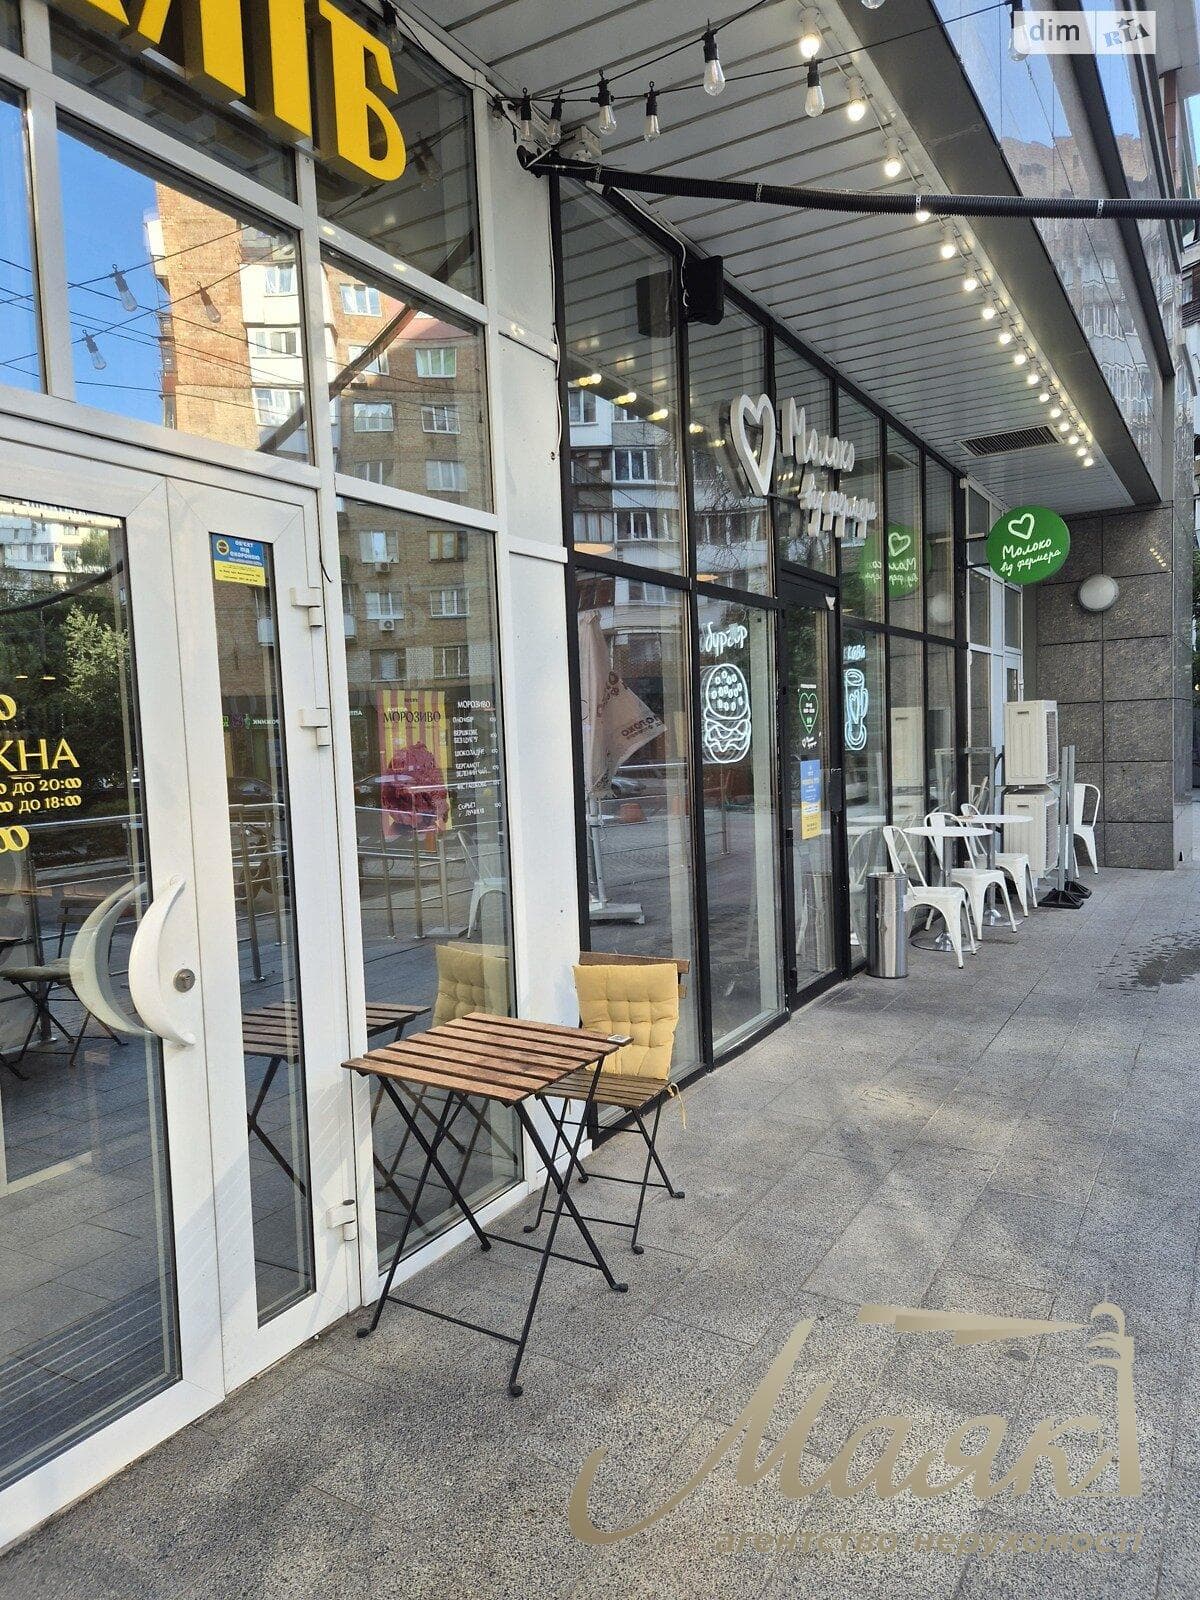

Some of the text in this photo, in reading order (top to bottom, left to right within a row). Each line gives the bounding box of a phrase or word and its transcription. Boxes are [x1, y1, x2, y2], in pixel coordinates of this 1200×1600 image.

[1002, 538, 1052, 560] Молоко
[1000, 549, 1061, 577] від фермера
[457, 700, 490, 709] МОРОЗИВО
[383, 711, 441, 723] МОРОЗИВО
[39, 777, 82, 792] 20:00
[45, 795, 82, 809] 18:00
